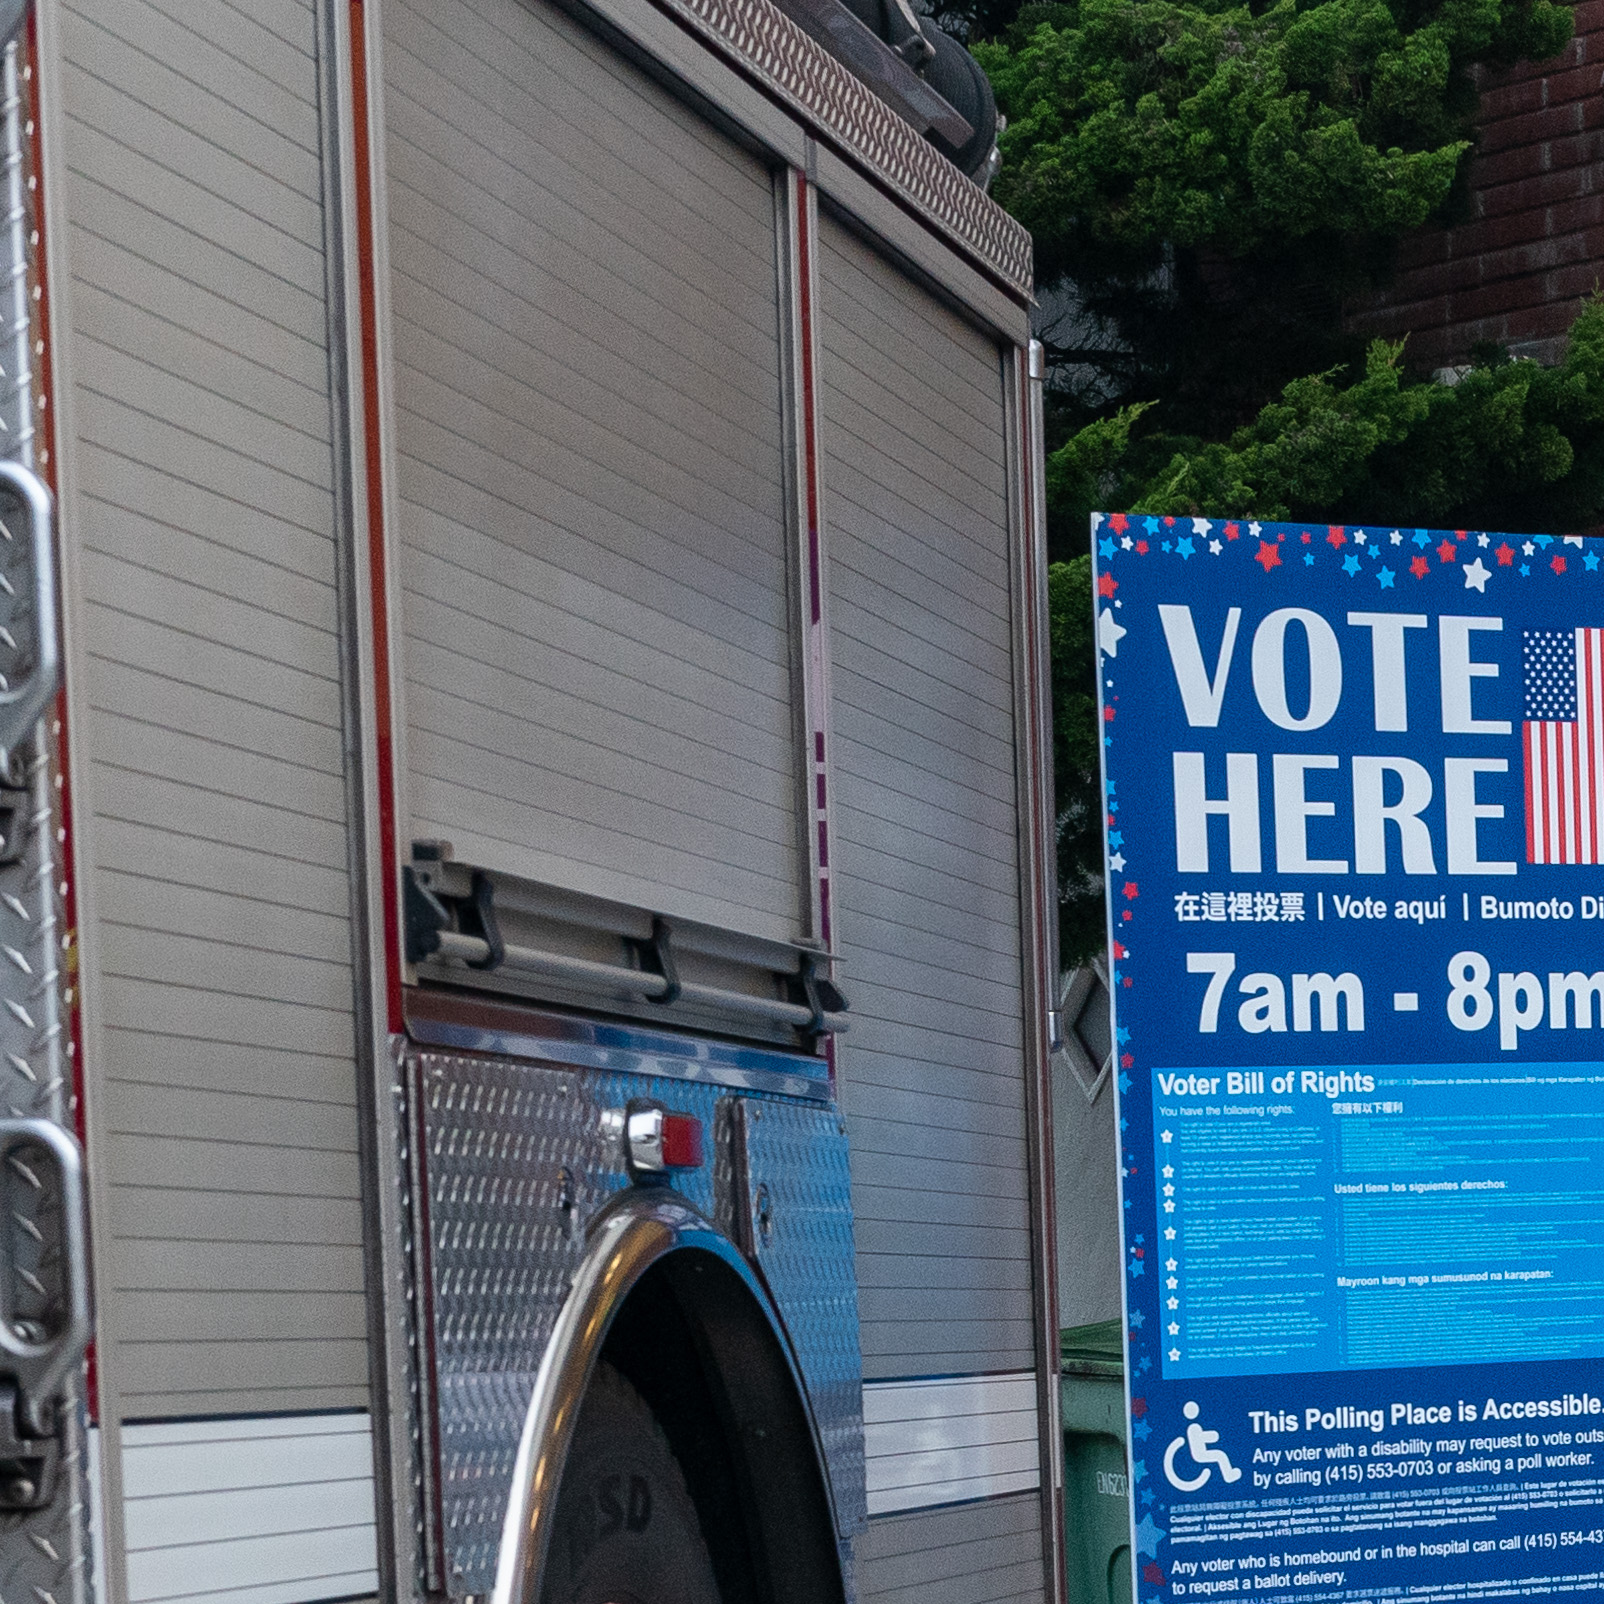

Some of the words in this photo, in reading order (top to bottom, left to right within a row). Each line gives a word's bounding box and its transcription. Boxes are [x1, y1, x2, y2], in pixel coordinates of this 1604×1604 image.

[1157, 603, 1512, 734] VOTE
[1172, 750, 1517, 876] HERE
[1174, 891, 1306, 922] 在這裡投票
[1333, 893, 1387, 919] Vote
[1394, 894, 1446, 924] aquí
[1480, 895, 1574, 920] Bumoto
[1186, 952, 1365, 1033] 7am
[1156, 1072, 1220, 1095] Voter
[1226, 1071, 1264, 1094] Bill
[1270, 1070, 1295, 1094] of
[1300, 1070, 1375, 1098] Rights
[1248, 1409, 1299, 1433] This
[1305, 1406, 1384, 1430] Polling
[1390, 1402, 1452, 1426] Place
[1458, 1400, 1477, 1422] is
[1252, 1447, 1281, 1466] Any
[1284, 1445, 1322, 1461] voter
[1324, 1442, 1354, 1459] with
[1358, 1444, 1367, 1457] a
[1370, 1438, 1432, 1457] disability
[1436, 1439, 1466, 1455] may
[1469, 1433, 1522, 1452] request
[1525, 1432, 1539, 1447] to
[1542, 1430, 1572, 1445] vote
[1253, 1470, 1271, 1489] by
[1275, 1467, 1321, 1486] calling
[1325, 1464, 1363, 1485] (415)
[1366, 1459, 1434, 1479] 553-0703
[1437, 1461, 1452, 1474] or
[1455, 1456, 1501, 1475] asking
[1504, 1457, 1514, 1470] a
[1517, 1453, 1542, 1472] poll
[1545, 1452, 1594, 1467] worker.
[1170, 1560, 1198, 1577] Any
[1200, 1557, 1235, 1572] voter
[1237, 1554, 1266, 1569] who
[1269, 1553, 1281, 1567] is
[1283, 1546, 1361, 1566] homebound
[1363, 1548, 1378, 1560] or
[1381, 1545, 1393, 1559] in
[1396, 1543, 1417, 1558] the
[1419, 1539, 1469, 1557] hospital
[1472, 1540, 1496, 1552] can
[1498, 1535, 1521, 1550] call
[1524, 1532, 1557, 1551] (415)
[1171, 1581, 1186, 1595] to
[1188, 1576, 1239, 1595] request
[1242, 1578, 1251, 1590] a
[1254, 1573, 1290, 1589] ballot
[1293, 1570, 1346, 1586] delivery.
